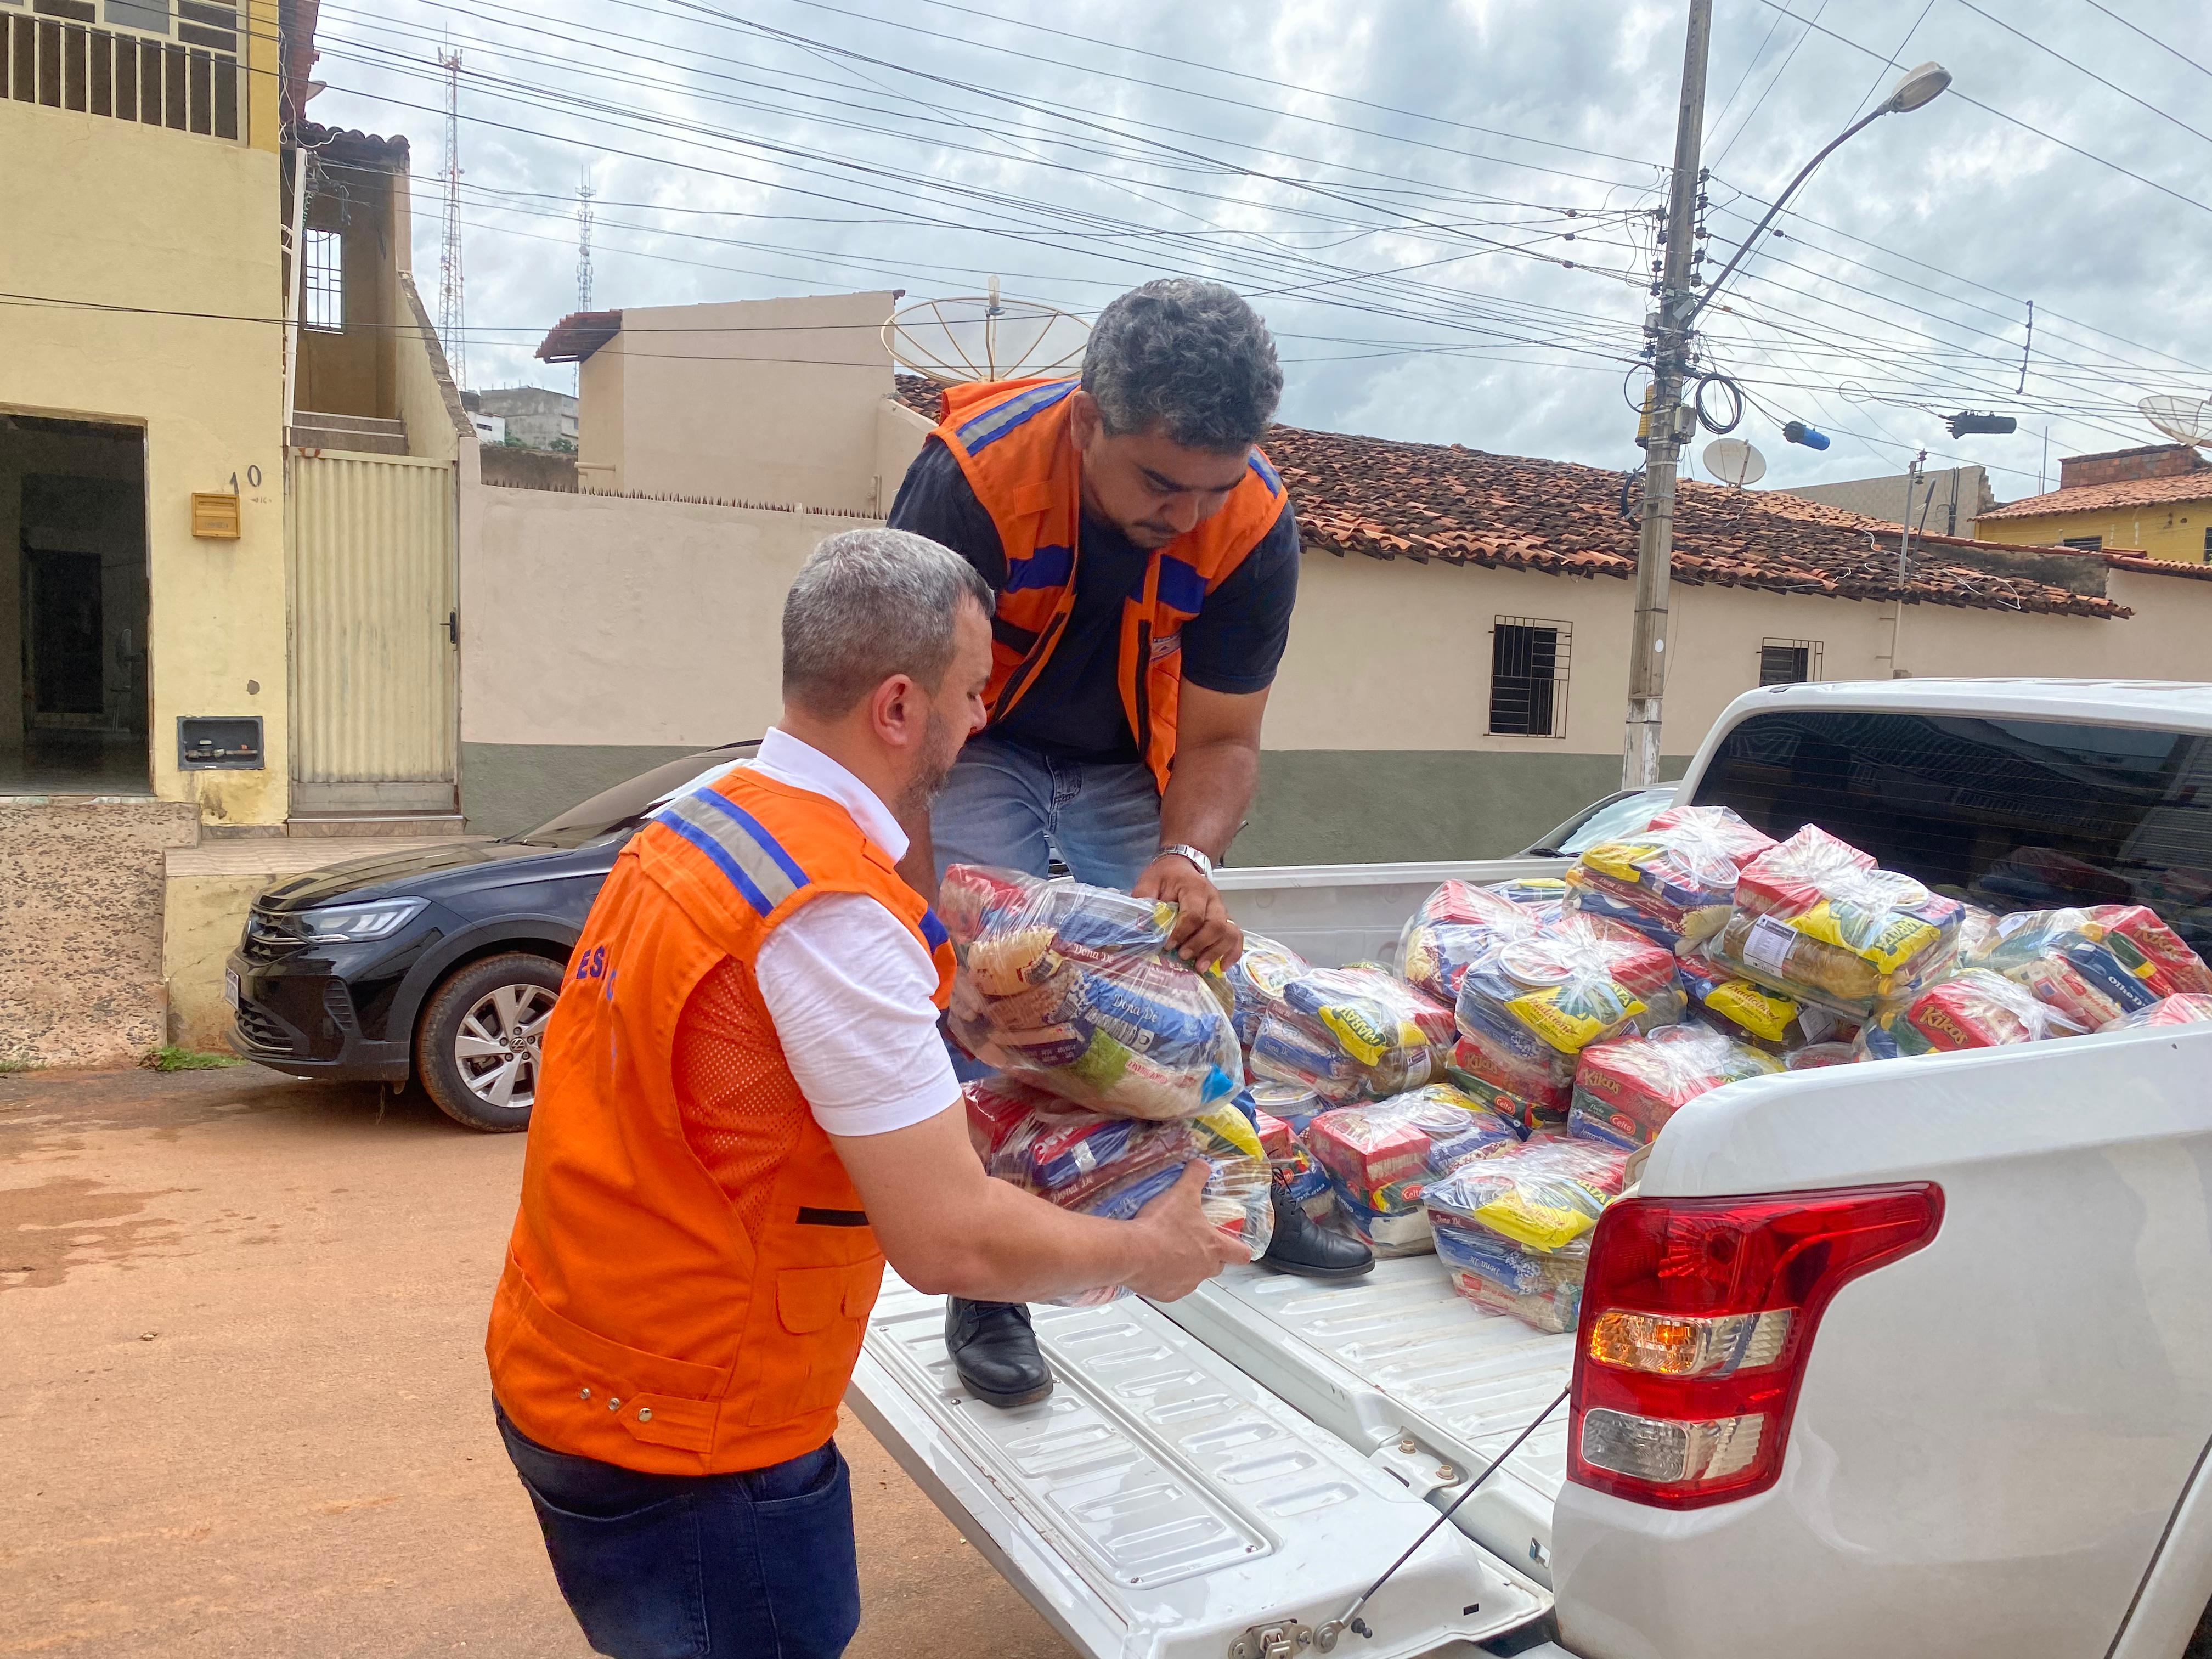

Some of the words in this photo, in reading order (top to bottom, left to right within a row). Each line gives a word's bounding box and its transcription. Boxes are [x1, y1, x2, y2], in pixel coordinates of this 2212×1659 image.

[1074, 943, 1099, 962] Dona
[2108, 975, 2133, 998] Olho
[1111, 992, 1140, 1016] Dona
[1918, 1005, 1969, 1046] Kikos
[1465, 1052, 1499, 1075] Kikos
[1583, 1068, 1623, 1096] Kikos
[1496, 1098, 1513, 1113] Celta
[1612, 1116, 1633, 1132] Celta
[1436, 1215, 1451, 1225] Dona
[1481, 1261, 1501, 1278] Dona
